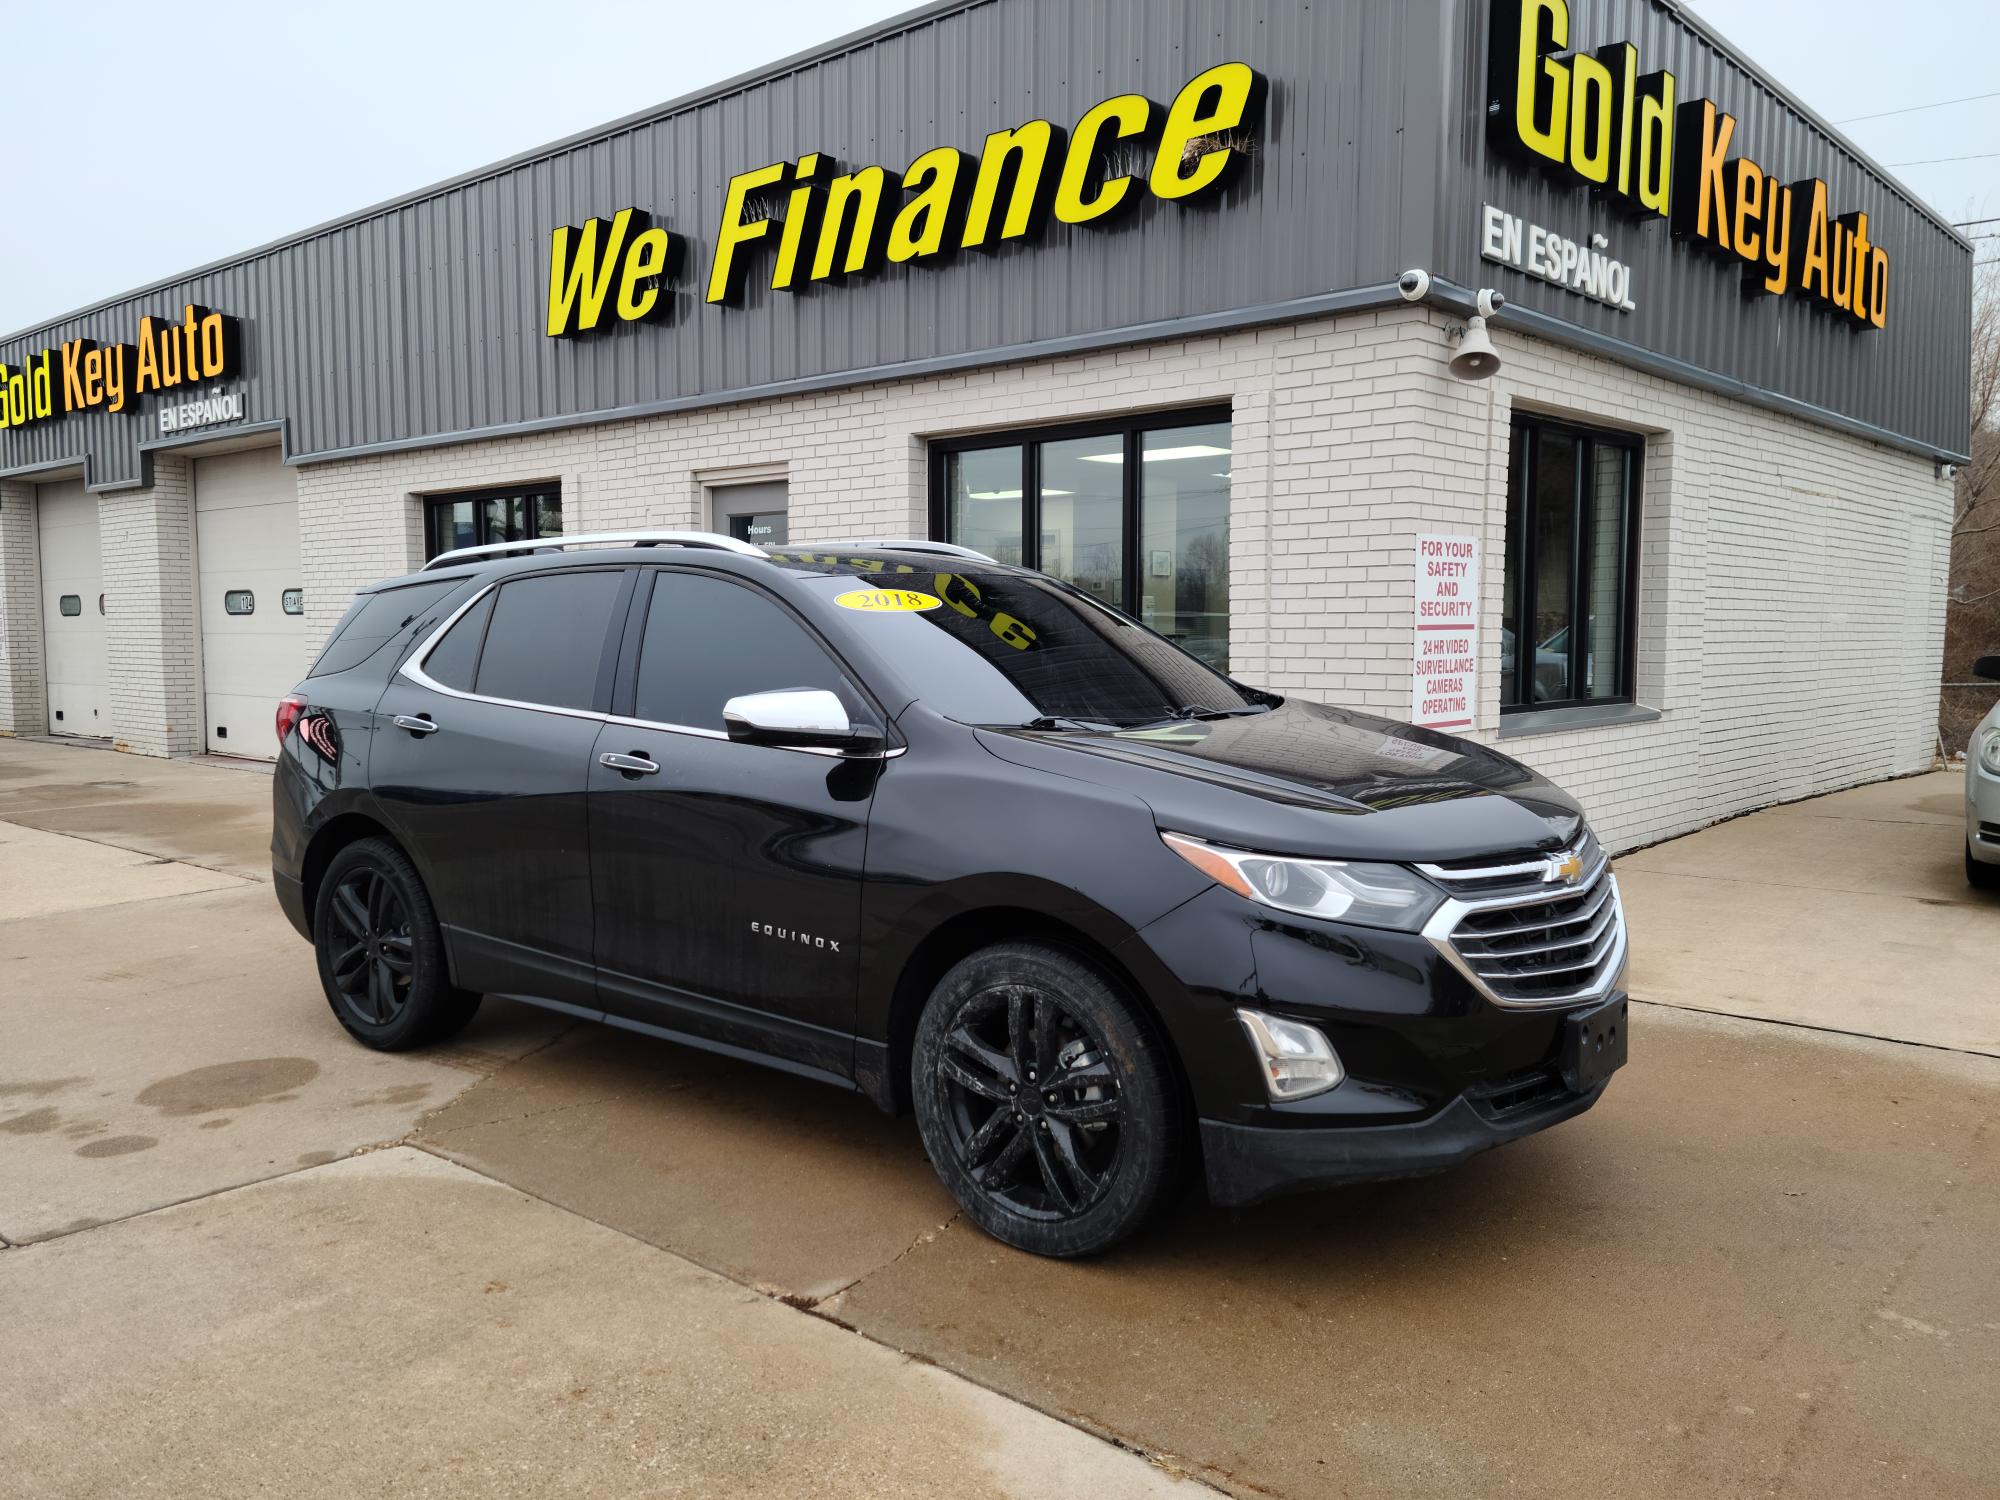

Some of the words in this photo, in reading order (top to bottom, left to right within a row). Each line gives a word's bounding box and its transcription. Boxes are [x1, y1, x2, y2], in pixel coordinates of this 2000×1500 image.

[1516, 0, 1675, 217] Gold
[1697, 98, 1792, 295] Key
[1802, 177, 1890, 329] Auto
[547, 207, 669, 337] We
[706, 61, 1255, 304] Finance
[1483, 204, 1522, 266] EN
[1528, 224, 1636, 312] ESPAÑOL
[62, 338, 125, 413] Key
[136, 304, 224, 394] Auto
[160, 407, 178, 432] EN
[180, 387, 242, 428] ESPAÑOL
[747, 525, 772, 535] Hours
[1421, 540, 1443, 557] FOR
[1445, 542, 1473, 558] YOUR
[1427, 561, 1467, 577] SAFETY
[1436, 582, 1458, 597] AND
[858, 593, 923, 608] 2018
[1420, 601, 1472, 617] SECURITY
[1423, 640, 1432, 655] 24
[1433, 639, 1444, 655] HR
[1446, 639, 1469, 654] VIDEO
[1416, 658, 1474, 675] SURVEILLANCE
[1426, 677, 1463, 694] CAMERAS
[1422, 696, 1466, 715] OPERATING
[751, 921, 840, 953] EQUINOX
